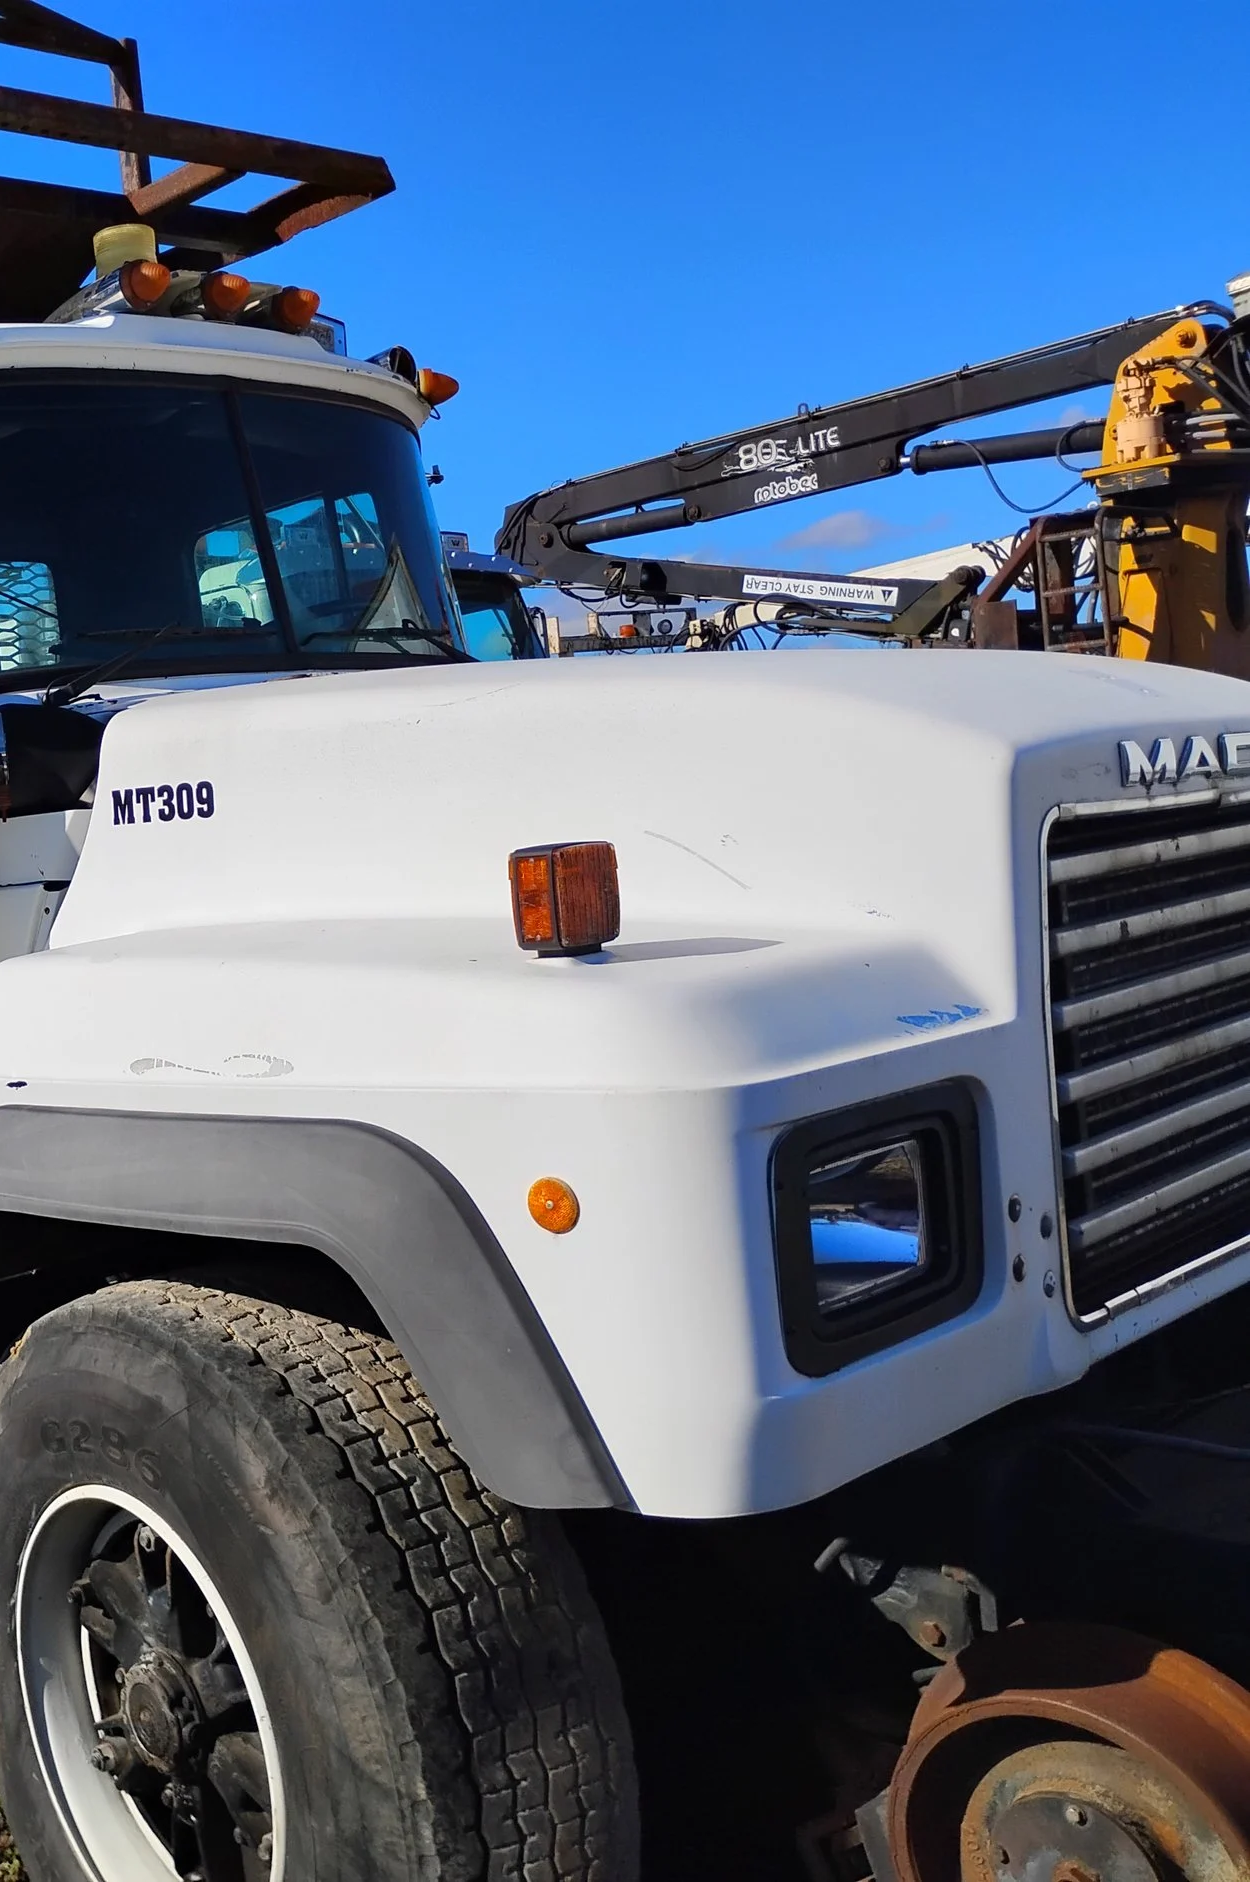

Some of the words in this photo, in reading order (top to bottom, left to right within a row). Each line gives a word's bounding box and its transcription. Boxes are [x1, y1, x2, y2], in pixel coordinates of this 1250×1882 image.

[790, 426, 841, 456] LITE
[754, 473, 819, 504] rotobec
[745, 579, 783, 592] CLEAR
[785, 583, 815, 595] STAY
[819, 585, 875, 600] WARNING
[111, 781, 215, 826] MT309
